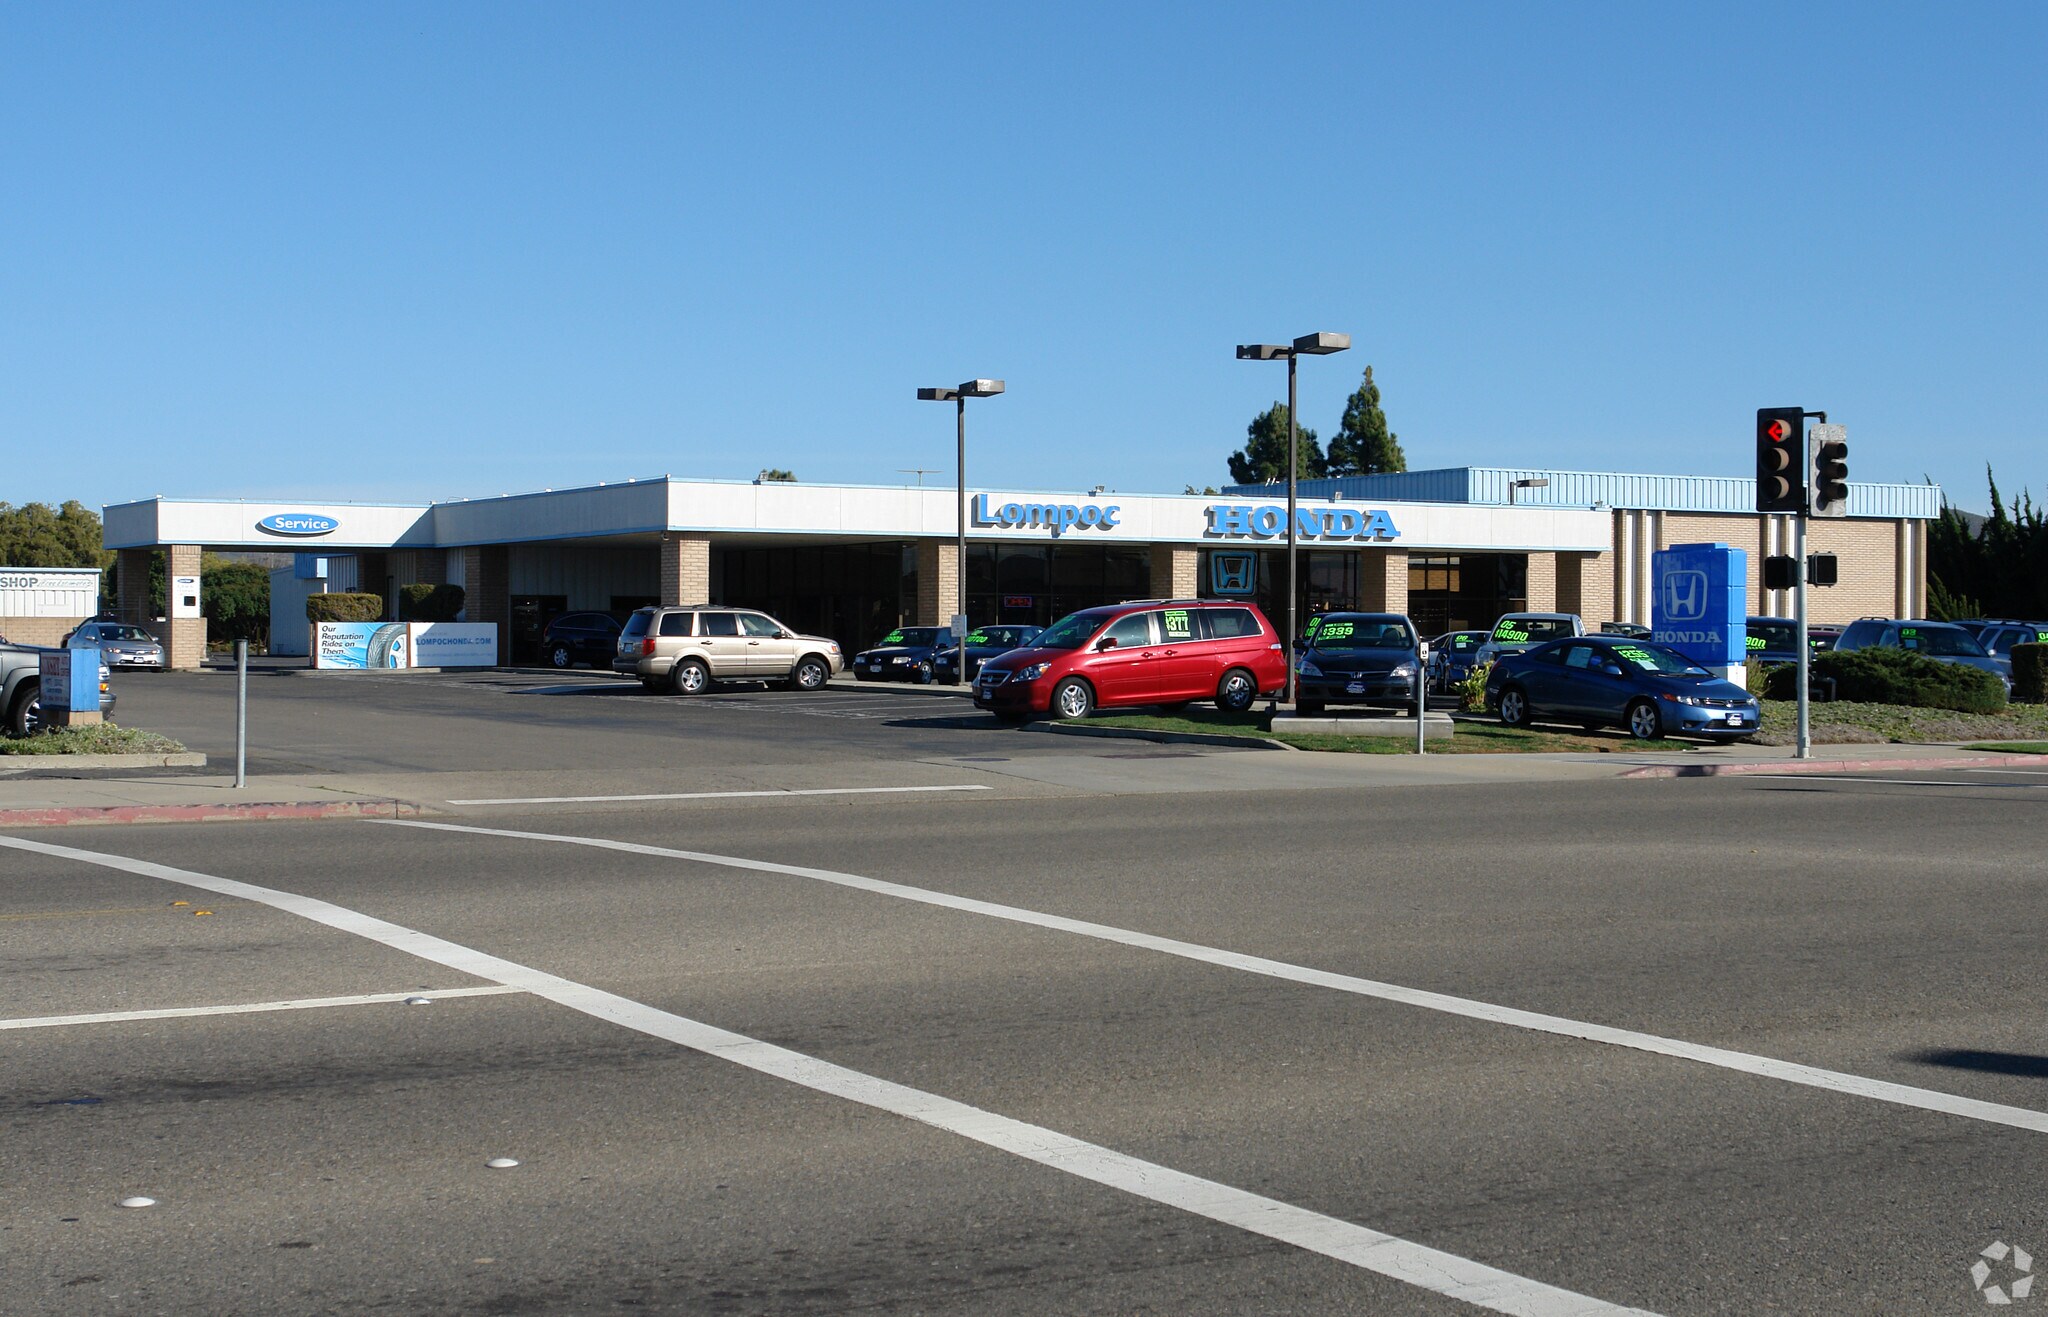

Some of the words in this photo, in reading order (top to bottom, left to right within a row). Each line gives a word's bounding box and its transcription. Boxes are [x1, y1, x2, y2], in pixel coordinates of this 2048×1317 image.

[976, 493, 1121, 535] Lompoc
[1208, 505, 1401, 537] HONDA
[275, 517, 329, 529] Service
[0, 577, 38, 588] SHOP
[1500, 620, 1516, 629] 05
[321, 633, 364, 641] Reputation
[1653, 631, 1723, 644] HONDA
[321, 640, 343, 648] Rides
[322, 647, 346, 655] Them.
